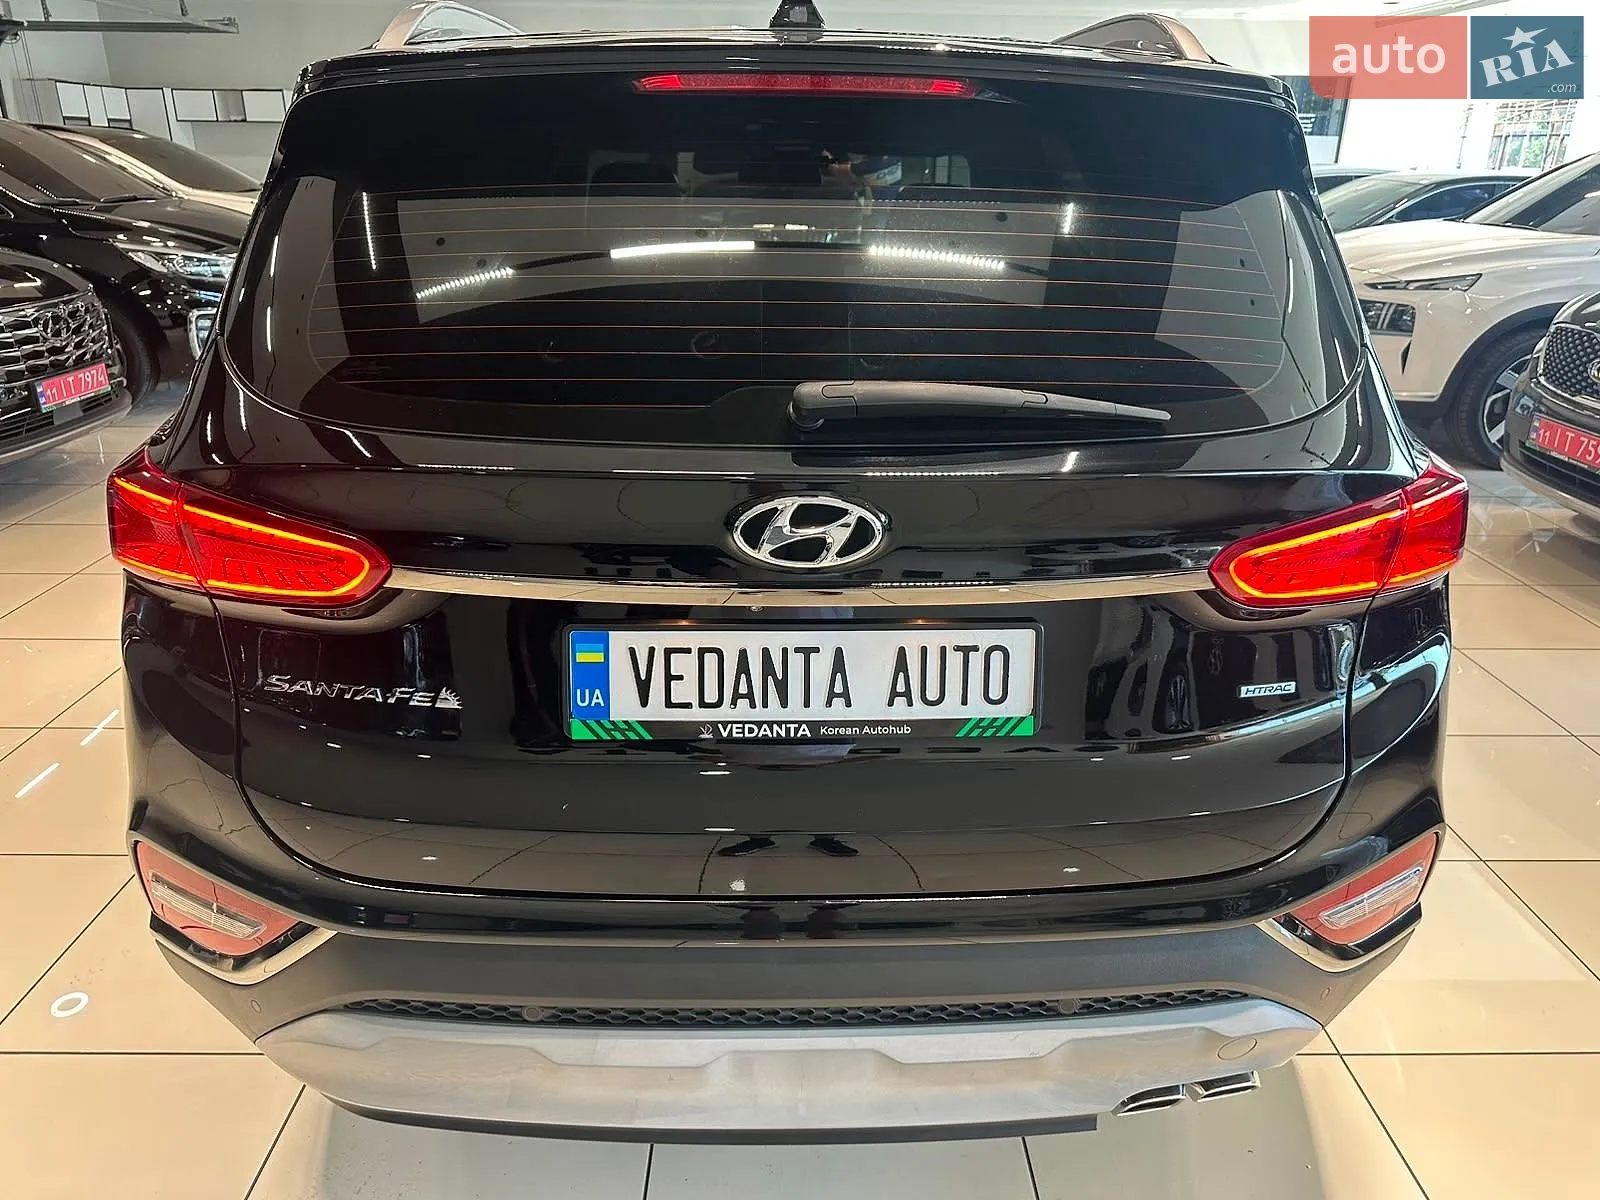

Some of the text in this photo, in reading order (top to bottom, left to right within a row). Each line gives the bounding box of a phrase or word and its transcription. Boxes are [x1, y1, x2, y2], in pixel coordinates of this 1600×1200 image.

[628, 644, 1010, 709] VEDANTA AUTO
[264, 674, 383, 703] SANTA
[576, 688, 605, 707] UA
[1244, 683, 1292, 696] HTRAC
[717, 723, 912, 738] VEDANTA Korean Autohub
